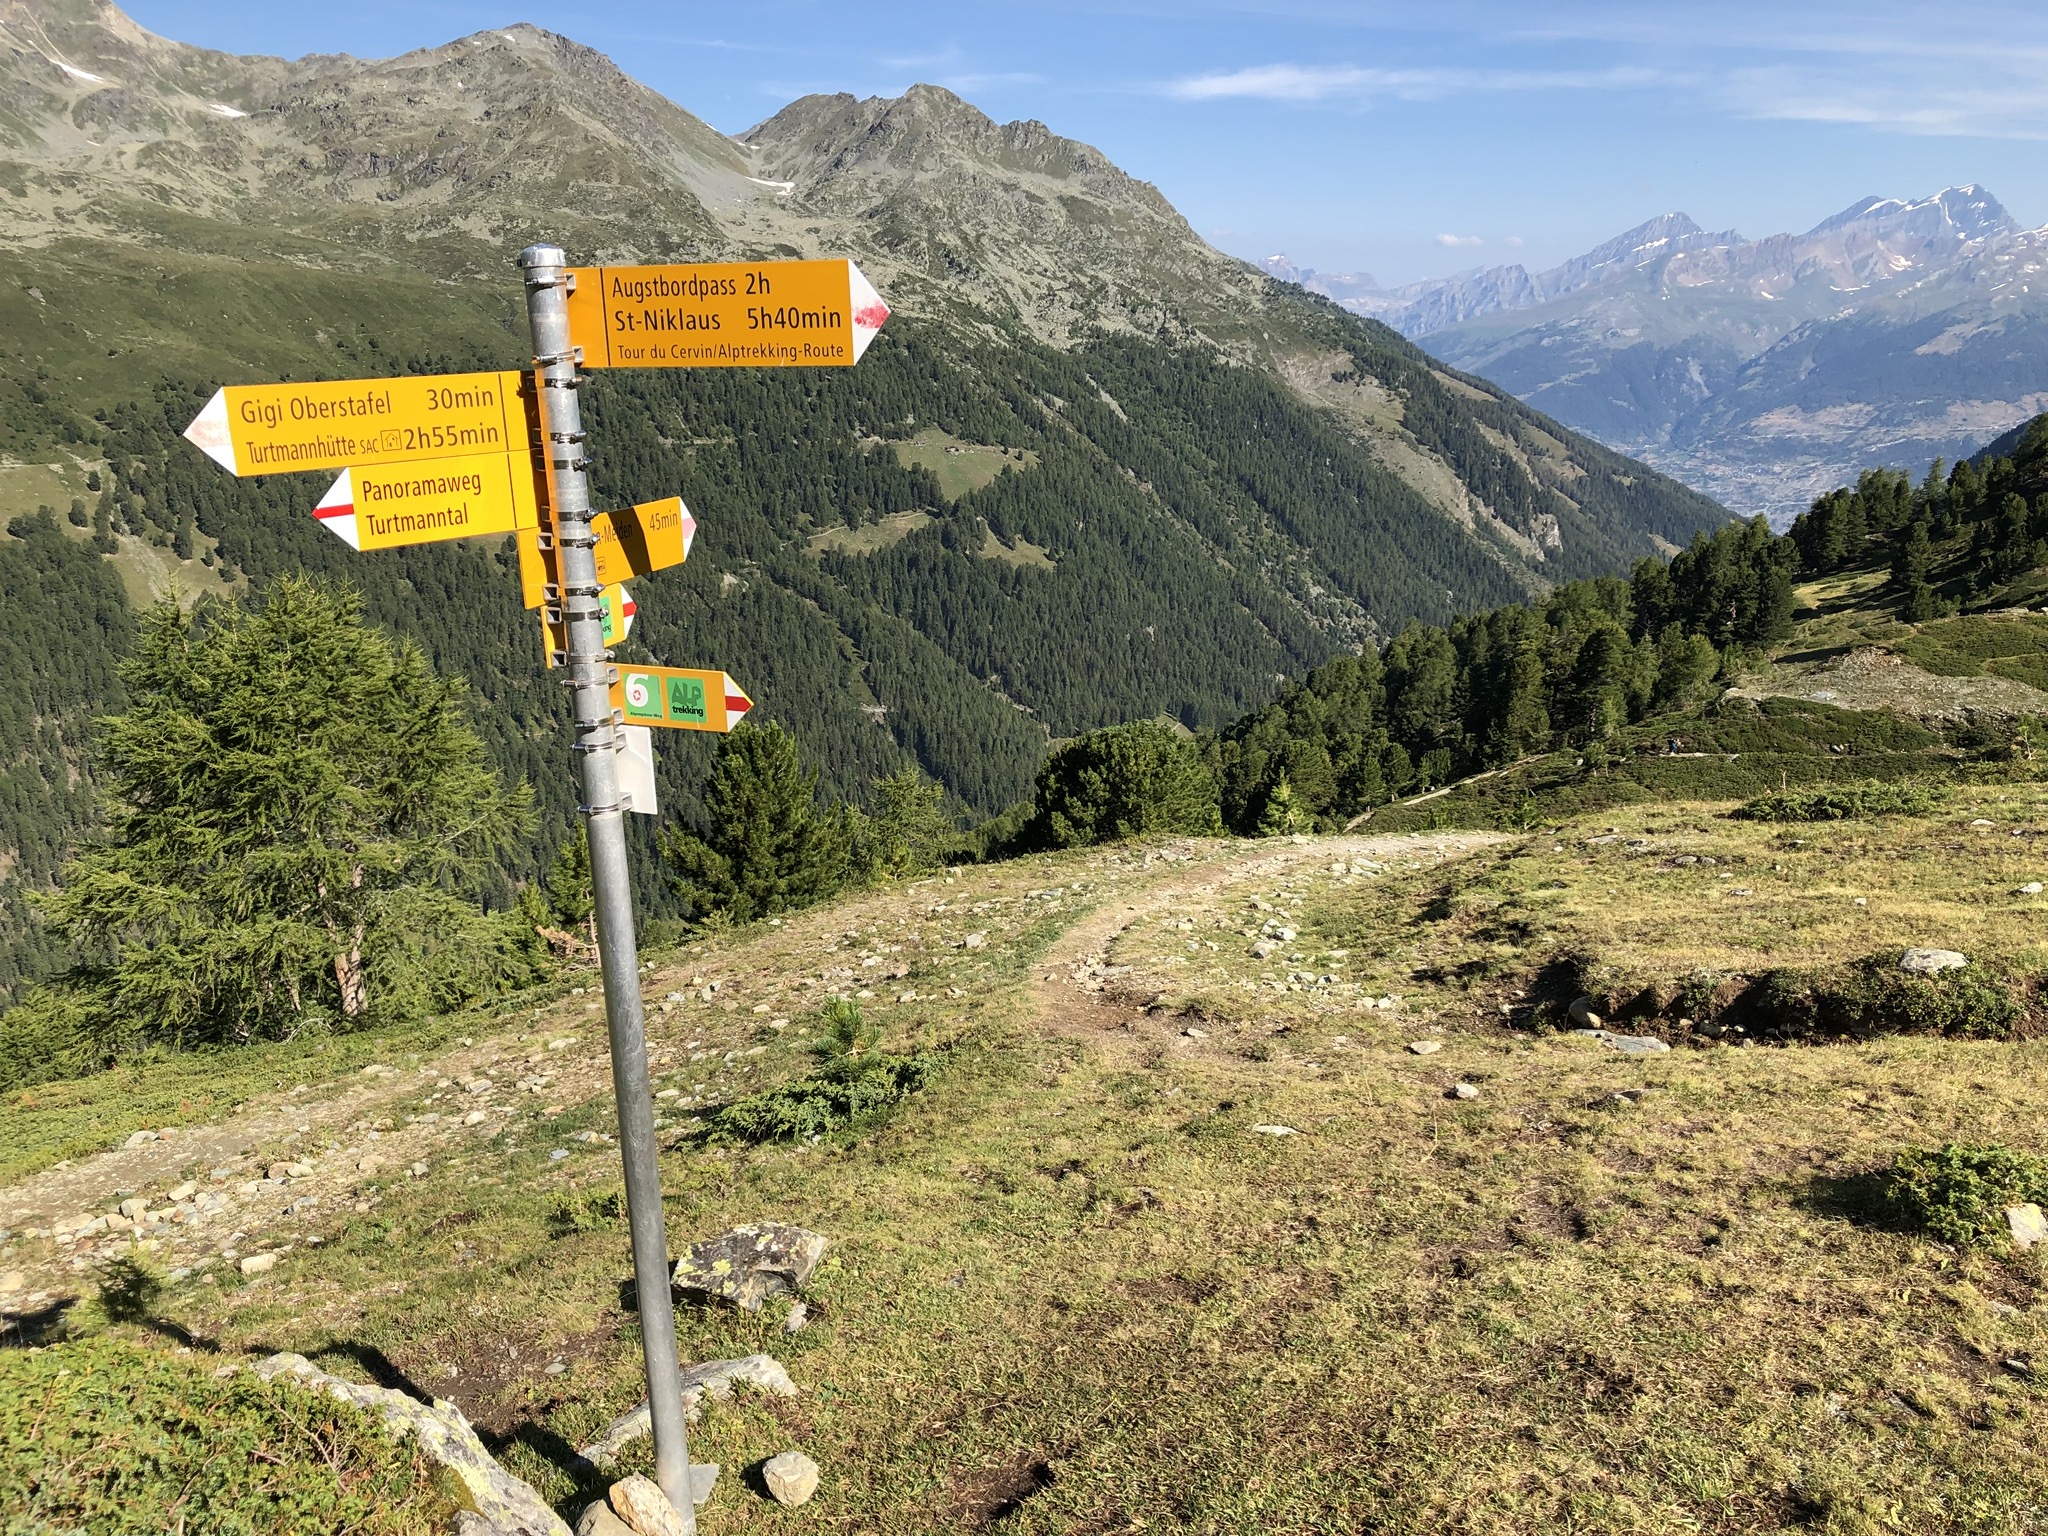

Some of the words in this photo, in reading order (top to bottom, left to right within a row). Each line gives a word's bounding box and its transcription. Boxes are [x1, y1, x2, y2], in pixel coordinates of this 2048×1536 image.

[612, 273, 736, 302] Augstbordpass
[745, 271, 771, 295] 2h
[614, 309, 721, 332] St-Niklaus
[747, 306, 841, 329] 5h40min
[617, 344, 645, 359] Tour
[650, 343, 666, 359] du
[671, 343, 844, 362] Cervin/Alptrekking-Route
[240, 399, 282, 429] Gigi
[290, 390, 391, 420] Oberstafel
[427, 385, 494, 411] 30min
[246, 435, 356, 465] Turtmannhütte
[360, 438, 379, 454] SAC
[403, 423, 499, 450] 2h55min
[362, 472, 482, 503] Panoramaweg
[366, 503, 469, 537] Turtmanntal
[649, 509, 678, 532] 45min
[625, 673, 649, 708] 6
[672, 706, 704, 717] trekking
